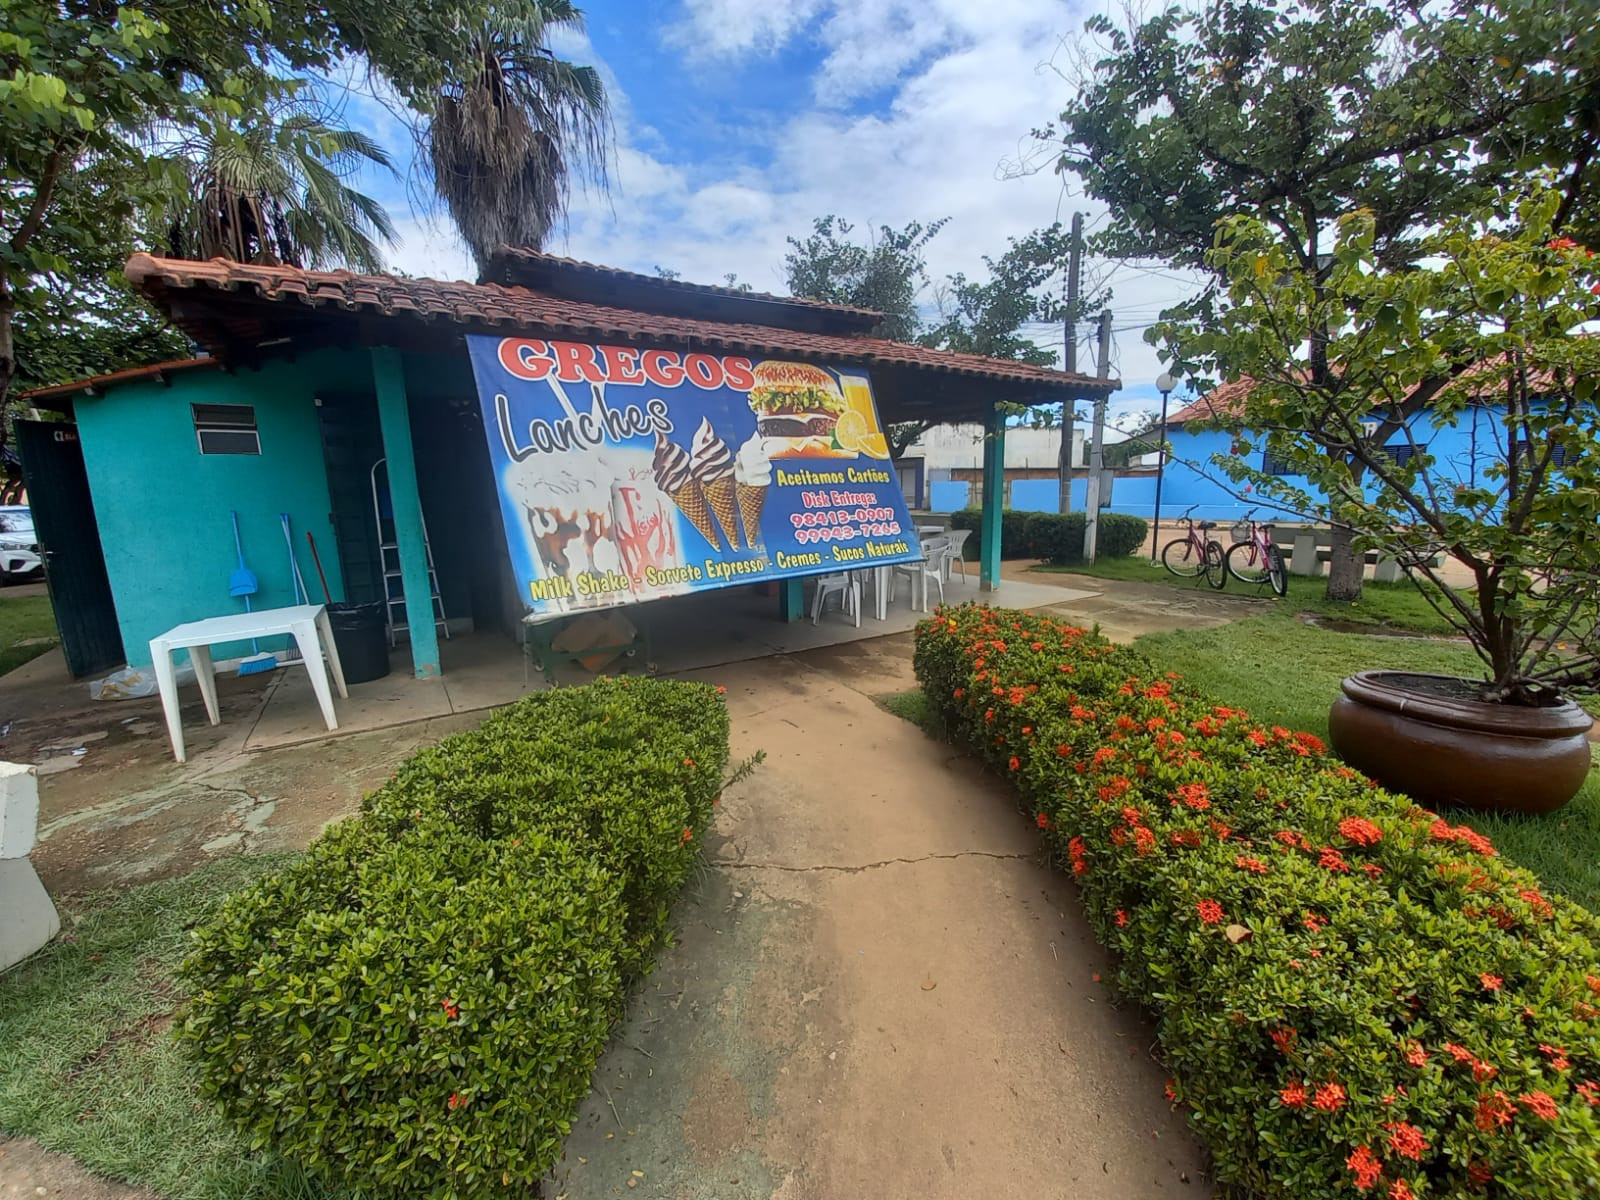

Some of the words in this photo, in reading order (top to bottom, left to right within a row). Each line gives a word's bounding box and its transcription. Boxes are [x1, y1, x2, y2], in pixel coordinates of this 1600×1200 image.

[499, 337, 755, 392] GREGOS
[496, 385, 673, 463] Lanches
[777, 469, 845, 486] Aceitamos
[848, 467, 890, 482] Cartões
[802, 491, 830, 508] Disk
[831, 490, 877, 508] Entrega:
[790, 508, 894, 527] 98413-0907
[795, 522, 901, 544] 99943-7265
[530, 575, 573, 601] Milk
[576, 569, 629, 595] Shake
[645, 564, 702, 586] Sorvete
[705, 556, 764, 580] Expresso
[776, 551, 821, 569] Cremes
[832, 545, 864, 562] Sucos
[867, 539, 909, 557] Naturais
